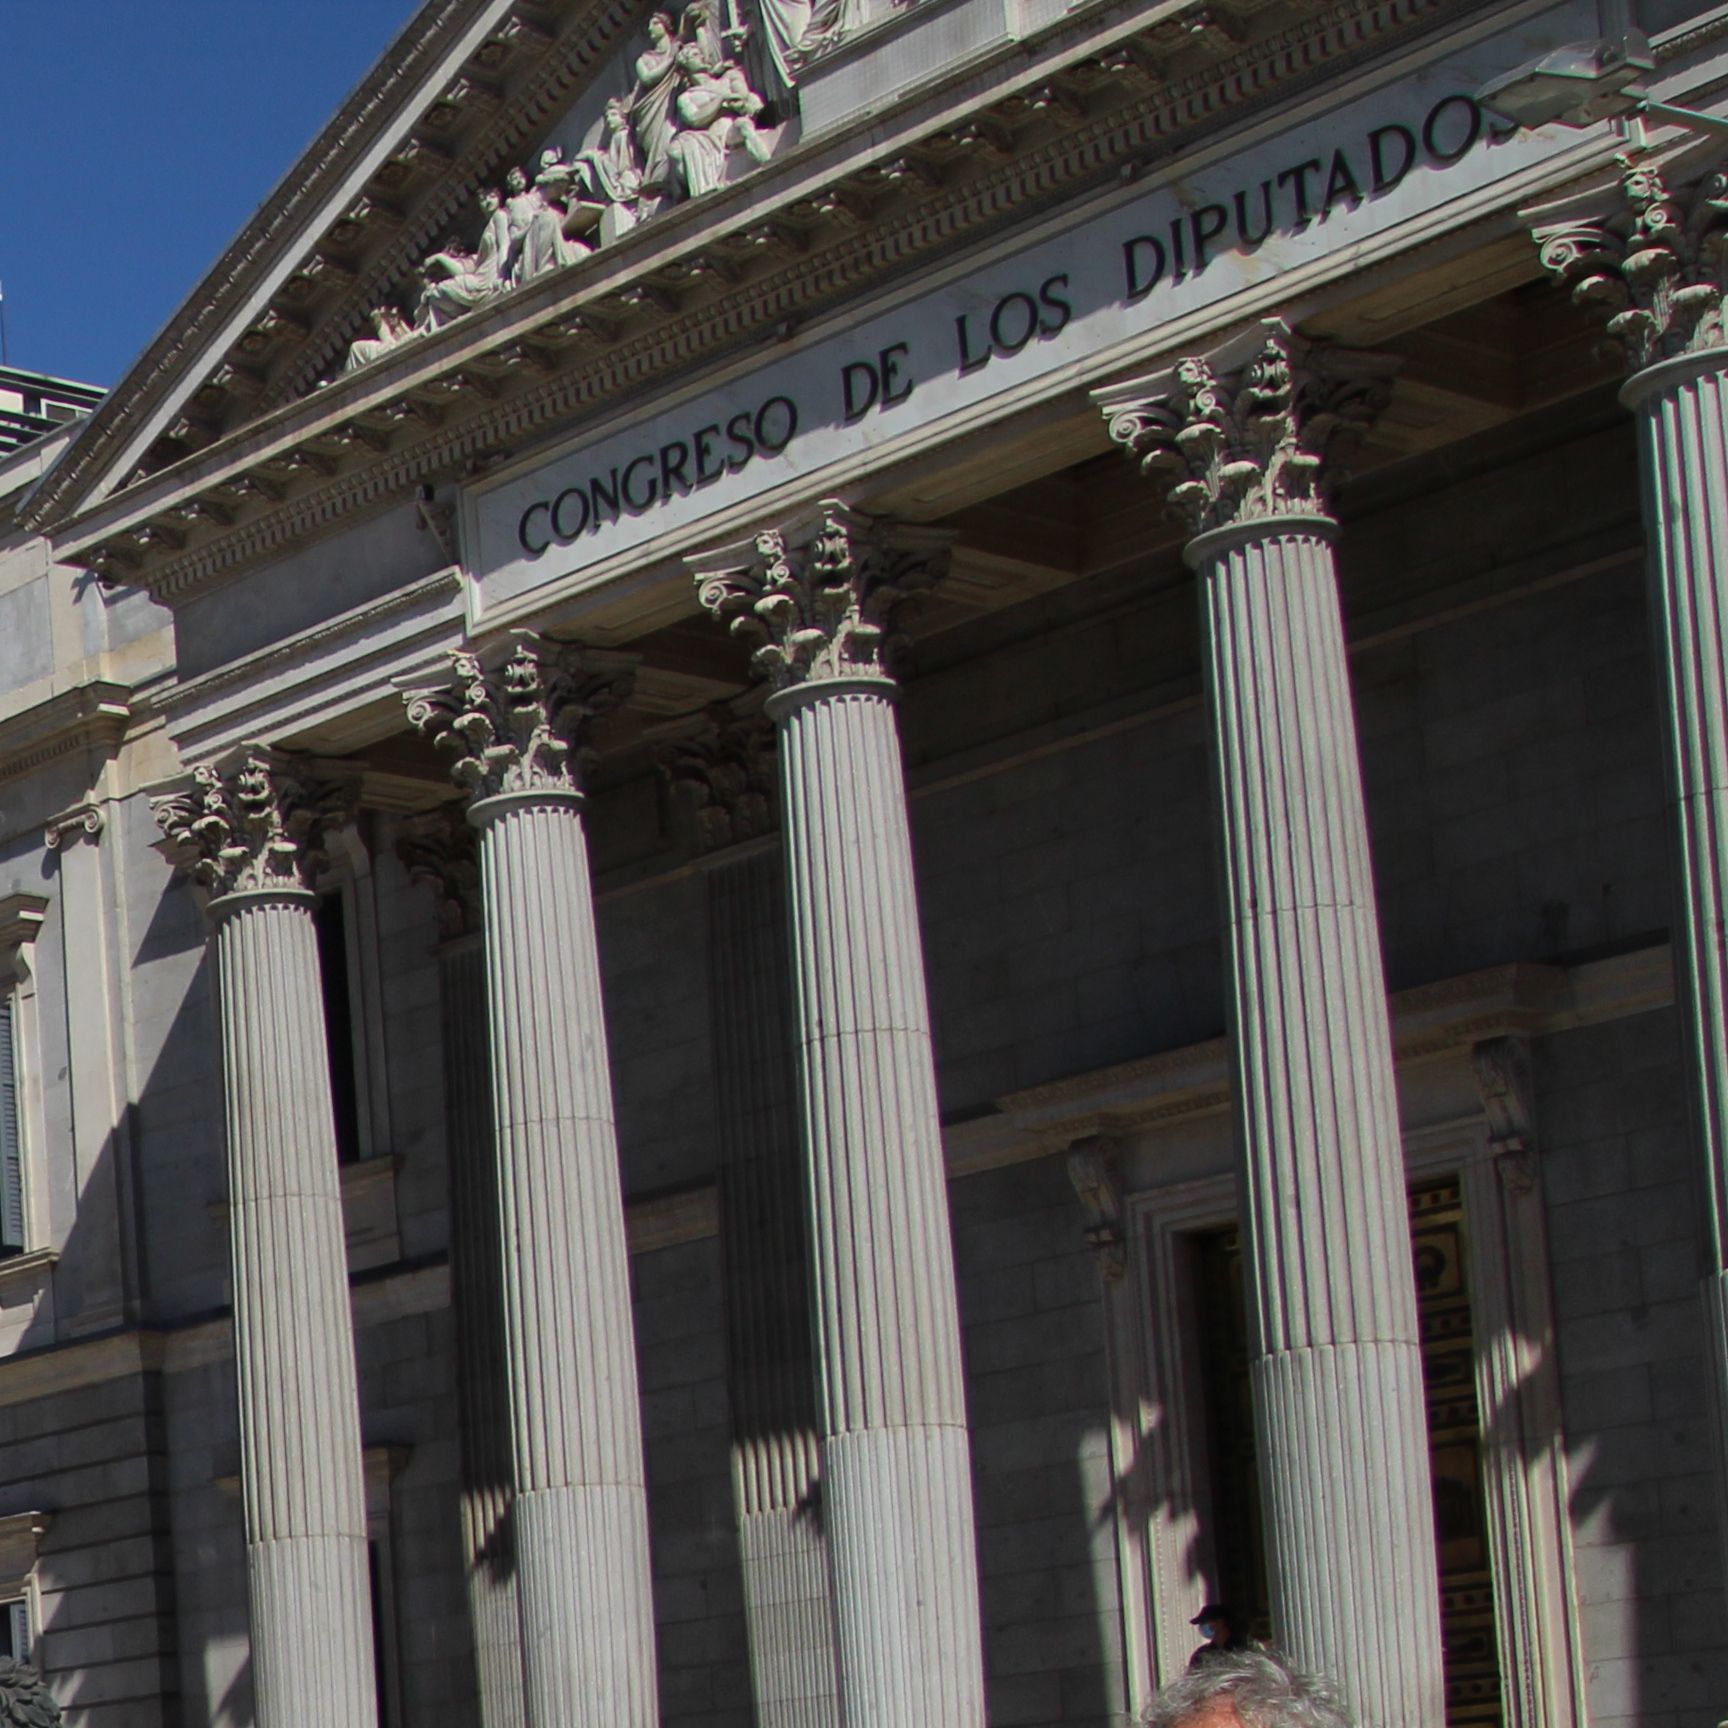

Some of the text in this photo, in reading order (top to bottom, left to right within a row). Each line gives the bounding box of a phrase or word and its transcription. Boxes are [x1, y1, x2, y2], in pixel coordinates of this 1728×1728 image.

[518, 393, 800, 557] CONGRESO
[841, 340, 914, 423] DE
[955, 272, 1073, 375] LOS
